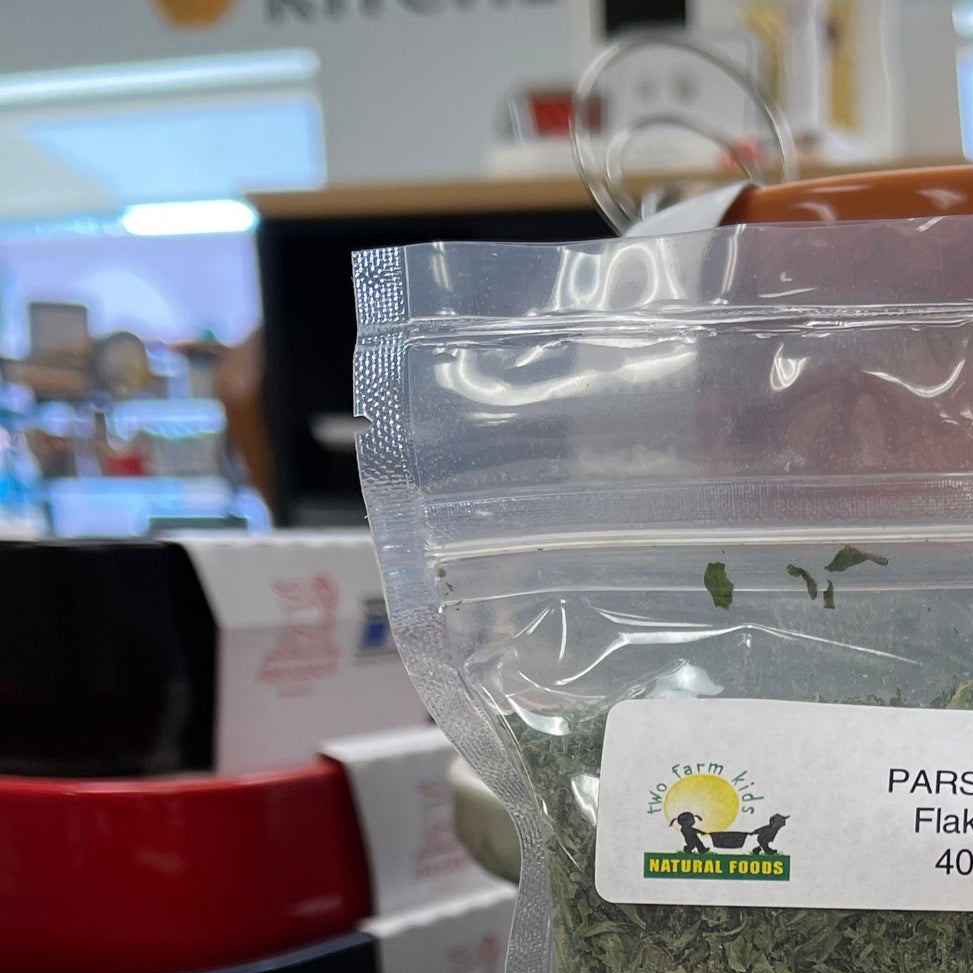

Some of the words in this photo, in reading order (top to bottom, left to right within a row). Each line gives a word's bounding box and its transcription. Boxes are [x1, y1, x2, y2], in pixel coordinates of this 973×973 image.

[647, 782, 668, 815] two
[671, 762, 724, 779] farm
[731, 770, 765, 815] kids
[649, 858, 723, 874] NATURAL
[729, 860, 784, 875] FOODS
